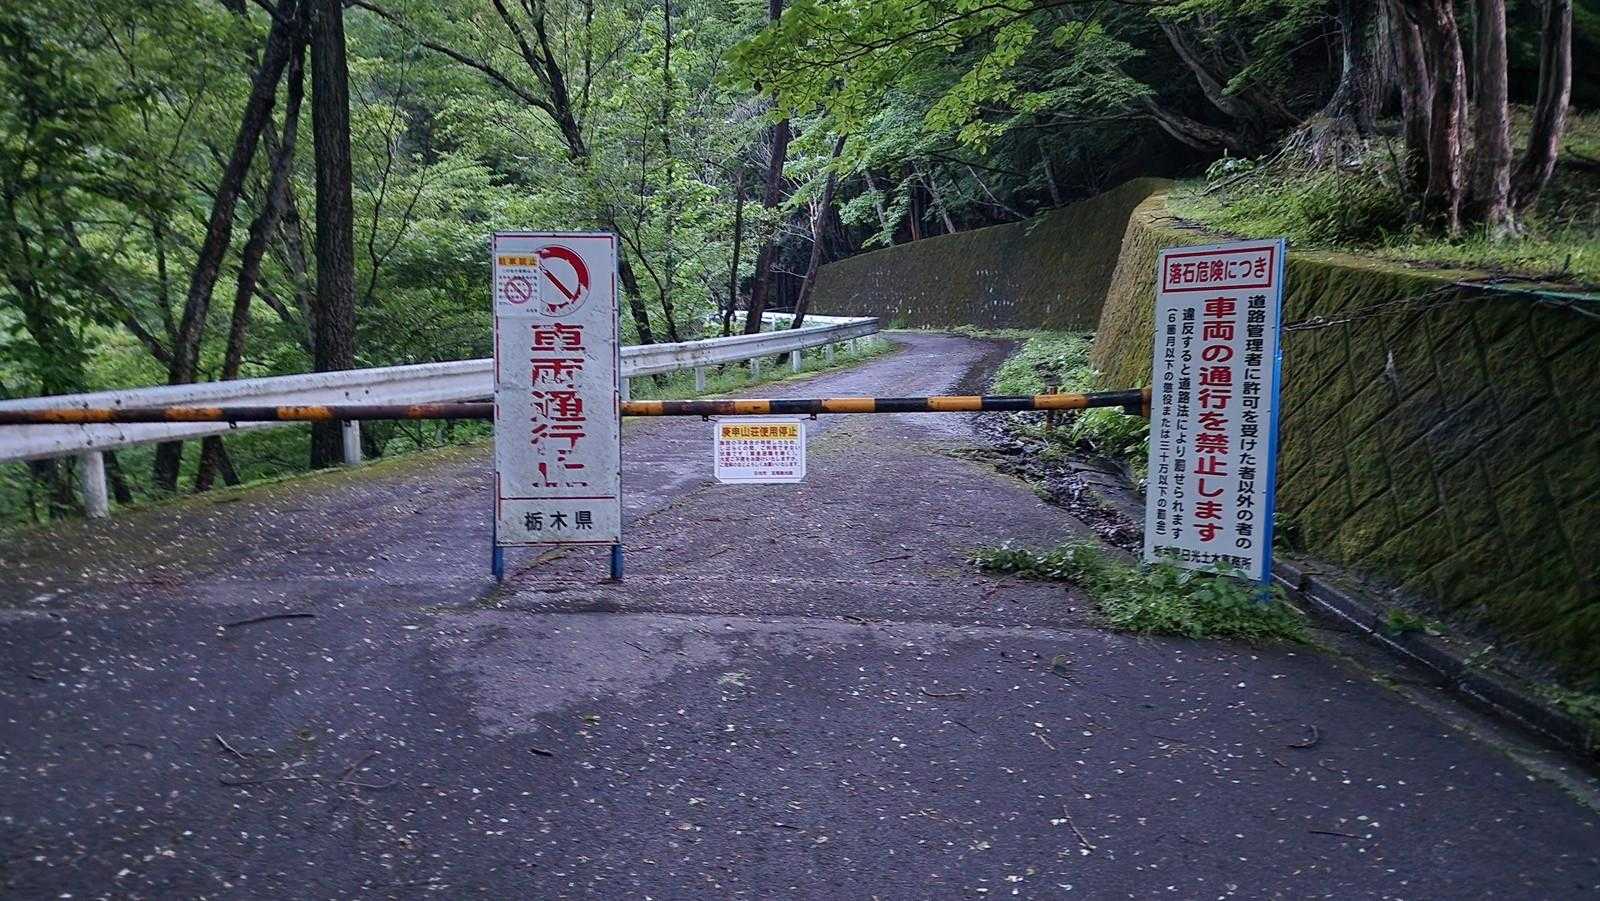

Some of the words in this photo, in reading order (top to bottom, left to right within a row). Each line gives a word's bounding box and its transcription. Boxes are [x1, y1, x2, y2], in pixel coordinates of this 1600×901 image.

[1169, 257, 1267, 284] 落石危険につき
[524, 510, 594, 532] 栃木県
[1172, 308, 1196, 539] 違反すると道路法により罰せられます
[1193, 297, 1238, 542] 車両の通行を禁止します
[1235, 295, 1267, 549] 道路管理者に許可を受けた者以外の者の
